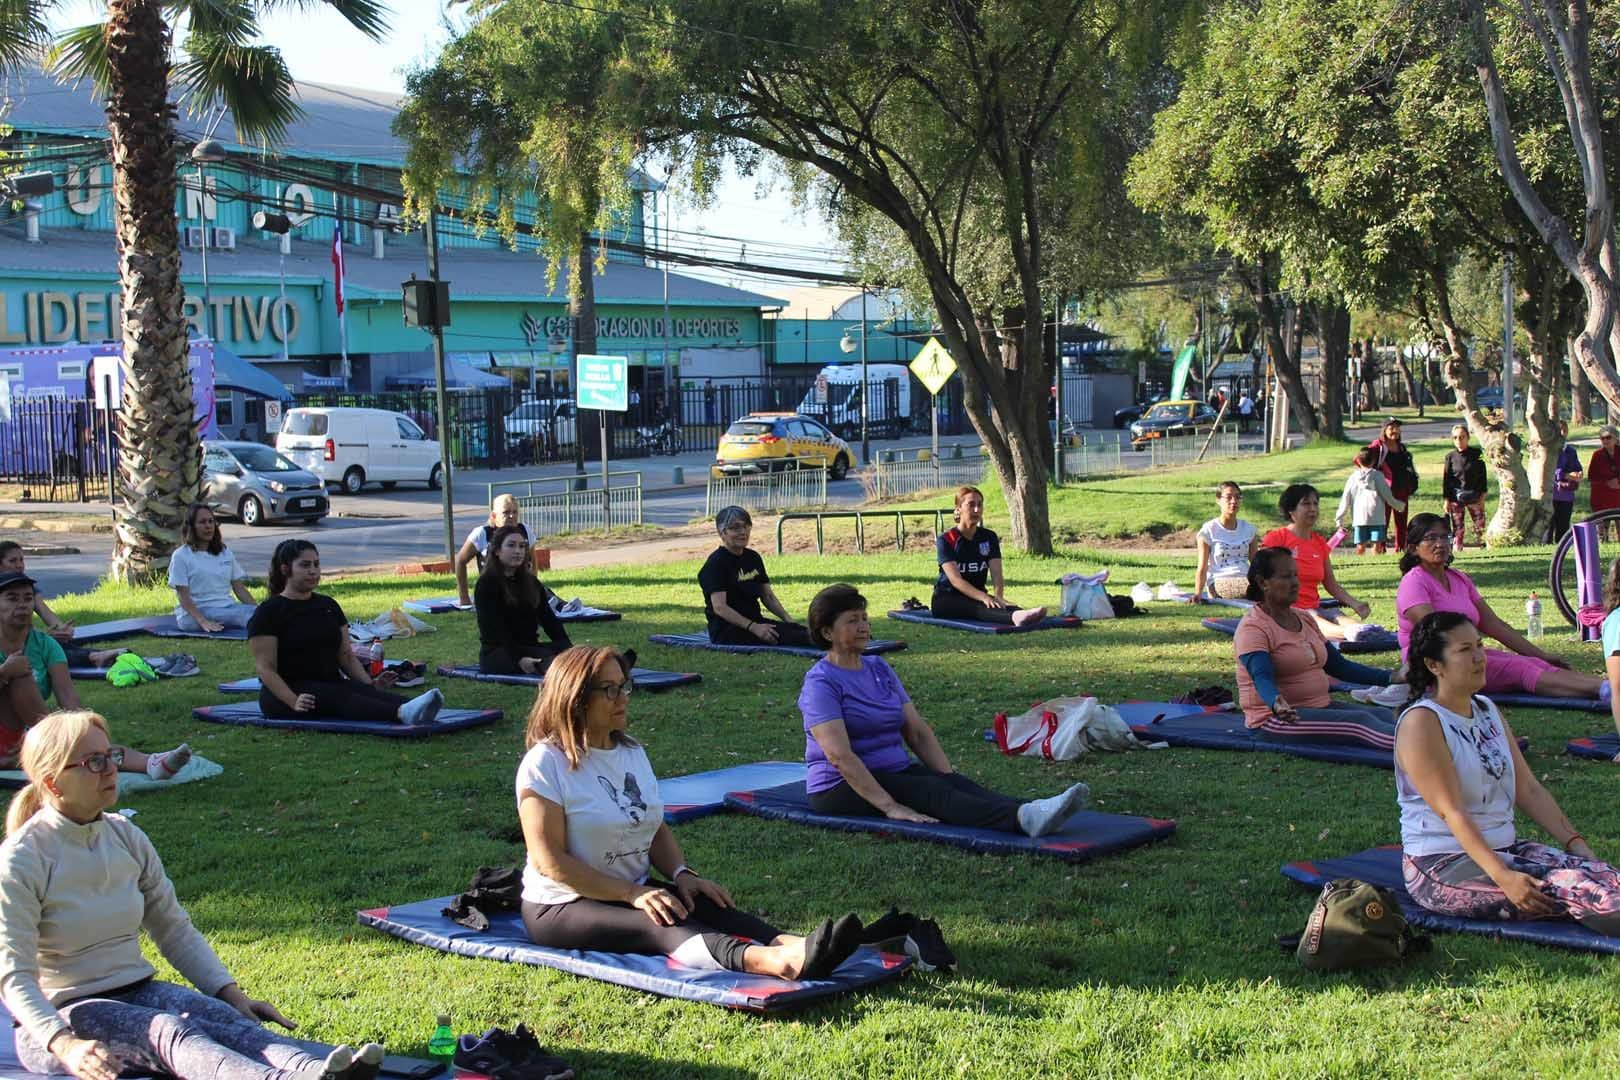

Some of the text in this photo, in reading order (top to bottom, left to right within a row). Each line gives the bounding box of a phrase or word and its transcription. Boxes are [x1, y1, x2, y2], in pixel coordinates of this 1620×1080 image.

[0, 291, 300, 343] LIDERTIVO
[546, 316, 651, 338] CORACION
[676, 318, 742, 338] DEPORTES
